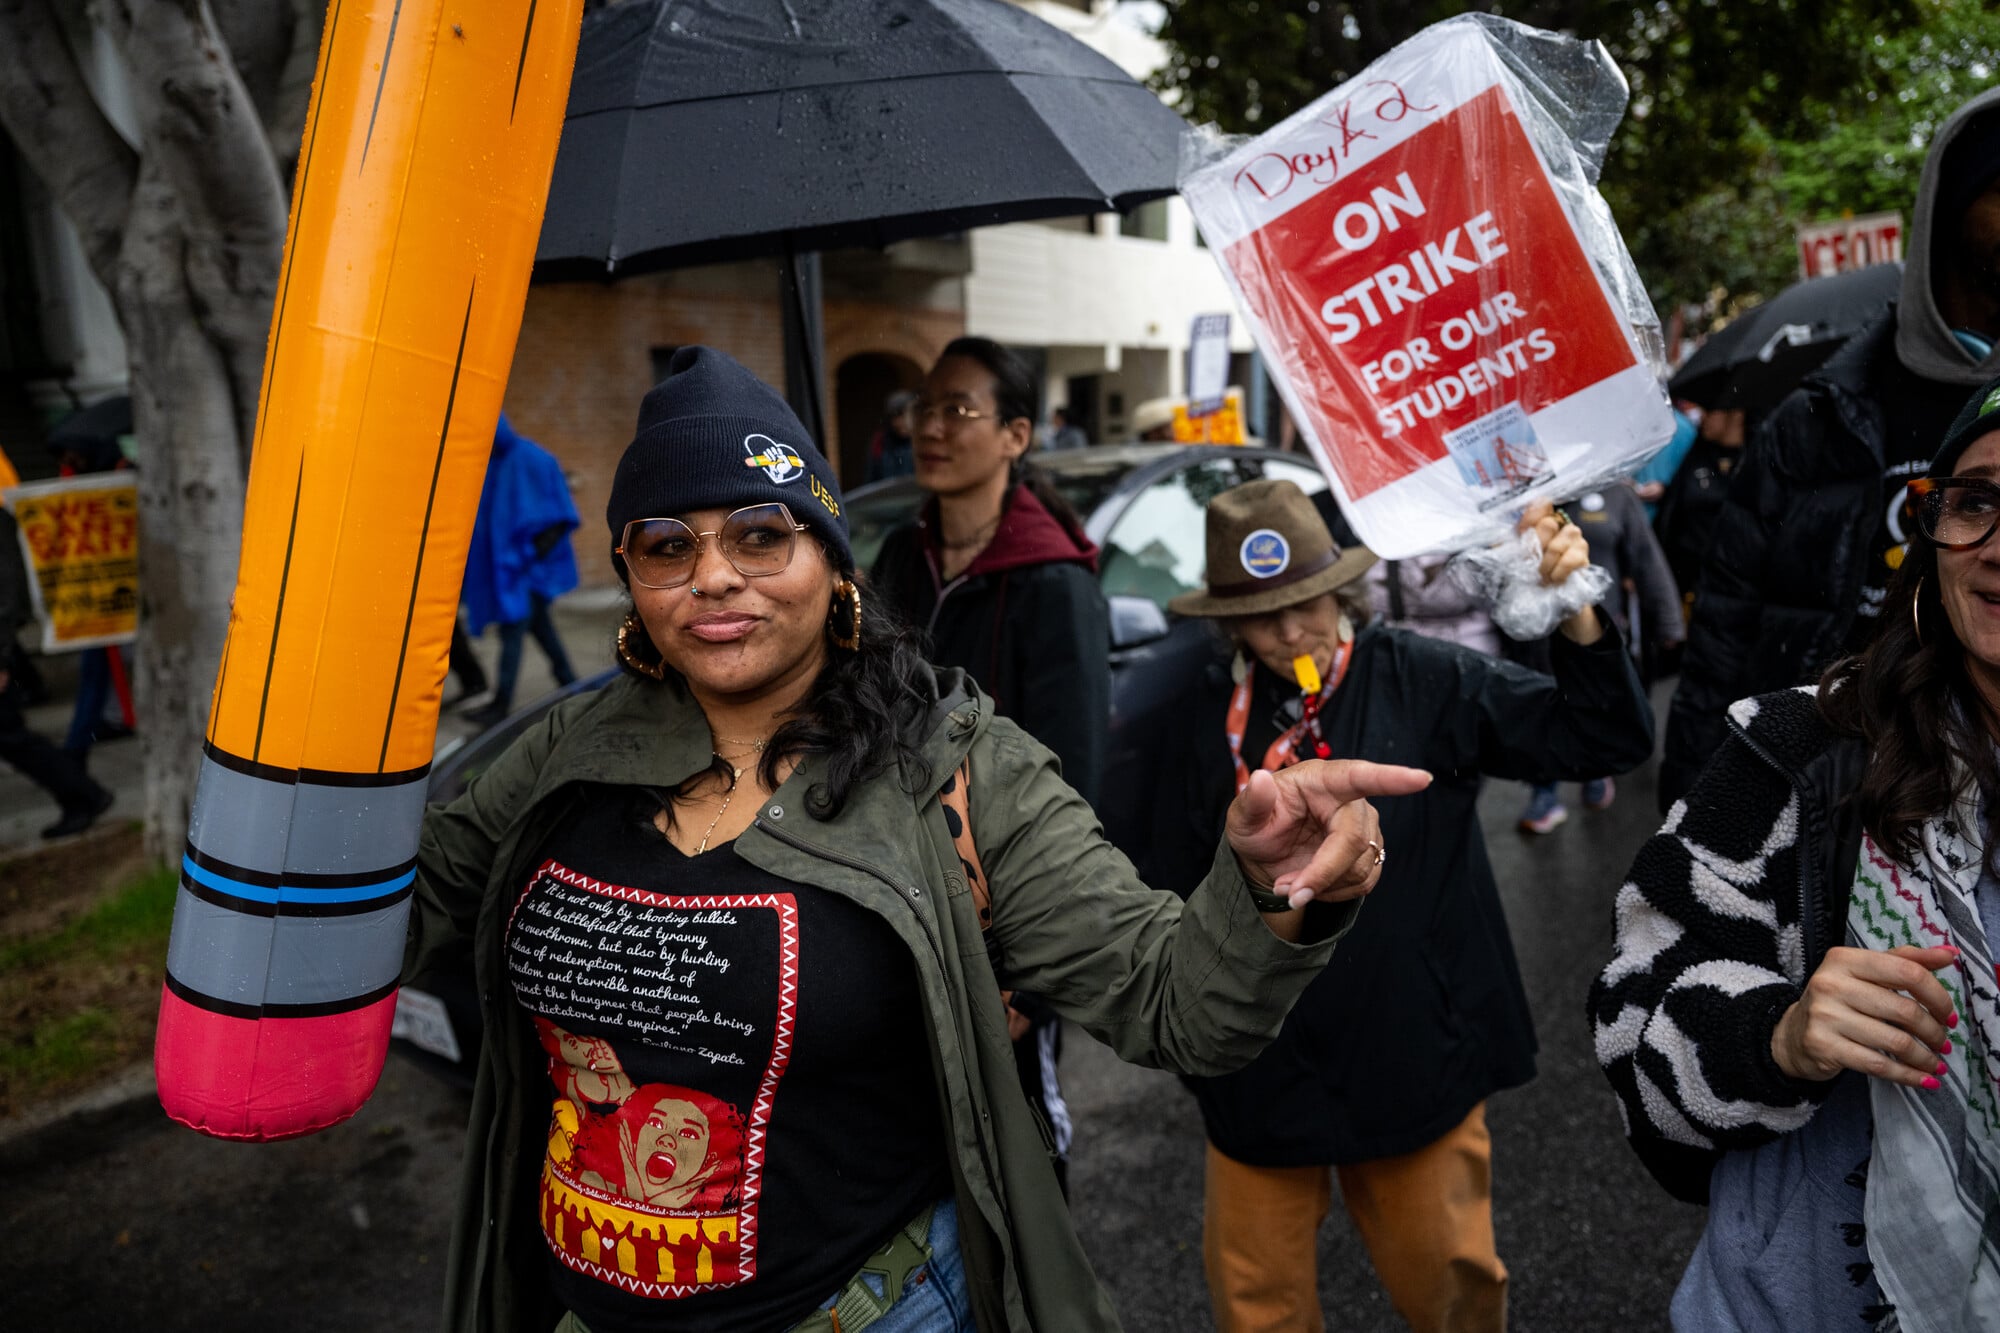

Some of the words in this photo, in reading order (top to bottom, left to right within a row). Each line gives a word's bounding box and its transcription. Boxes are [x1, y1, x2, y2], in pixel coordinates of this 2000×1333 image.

[1234, 146, 1338, 200] Day
[1366, 80, 1439, 122] 2
[1333, 171, 1426, 251] ON
[1321, 210, 1509, 345] STRIKE
[1361, 337, 1440, 395] FOR
[1440, 291, 1529, 351] OUR
[1377, 328, 1556, 439] STUDENTS
[527, 899, 535, 911] in
[536, 901, 552, 917] the
[553, 906, 622, 934] battlefield
[622, 923, 653, 938] that
[655, 926, 709, 950] tyranny
[567, 894, 590, 906] not
[588, 900, 614, 918] only
[616, 903, 633, 923] by
[636, 908, 690, 928] shooting
[692, 910, 738, 925] bullets
[511, 938, 532, 955] ideas
[534, 945, 548, 961] of
[549, 950, 628, 974] redemption,
[632, 966, 676, 982] words
[679, 970, 697, 988] of
[517, 918, 524, 930] is
[525, 924, 593, 949] overthrown,
[598, 937, 622, 953] but
[626, 942, 657, 958] also
[660, 945, 677, 966] by
[681, 948, 731, 973] hurling
[543, 985, 568, 1000] the
[571, 989, 628, 1010] hangmen
[630, 1001, 663, 1015] that
[665, 1009, 711, 1024] people
[713, 1012, 756, 1036] bring
[547, 970, 573, 984] and
[576, 972, 629, 993] terrible
[632, 985, 700, 1004] anathema
[538, 1001, 597, 1021] dictators
[600, 1013, 624, 1026] and
[627, 1019, 689, 1035] empires."
[698, 1046, 746, 1065] Zapata
